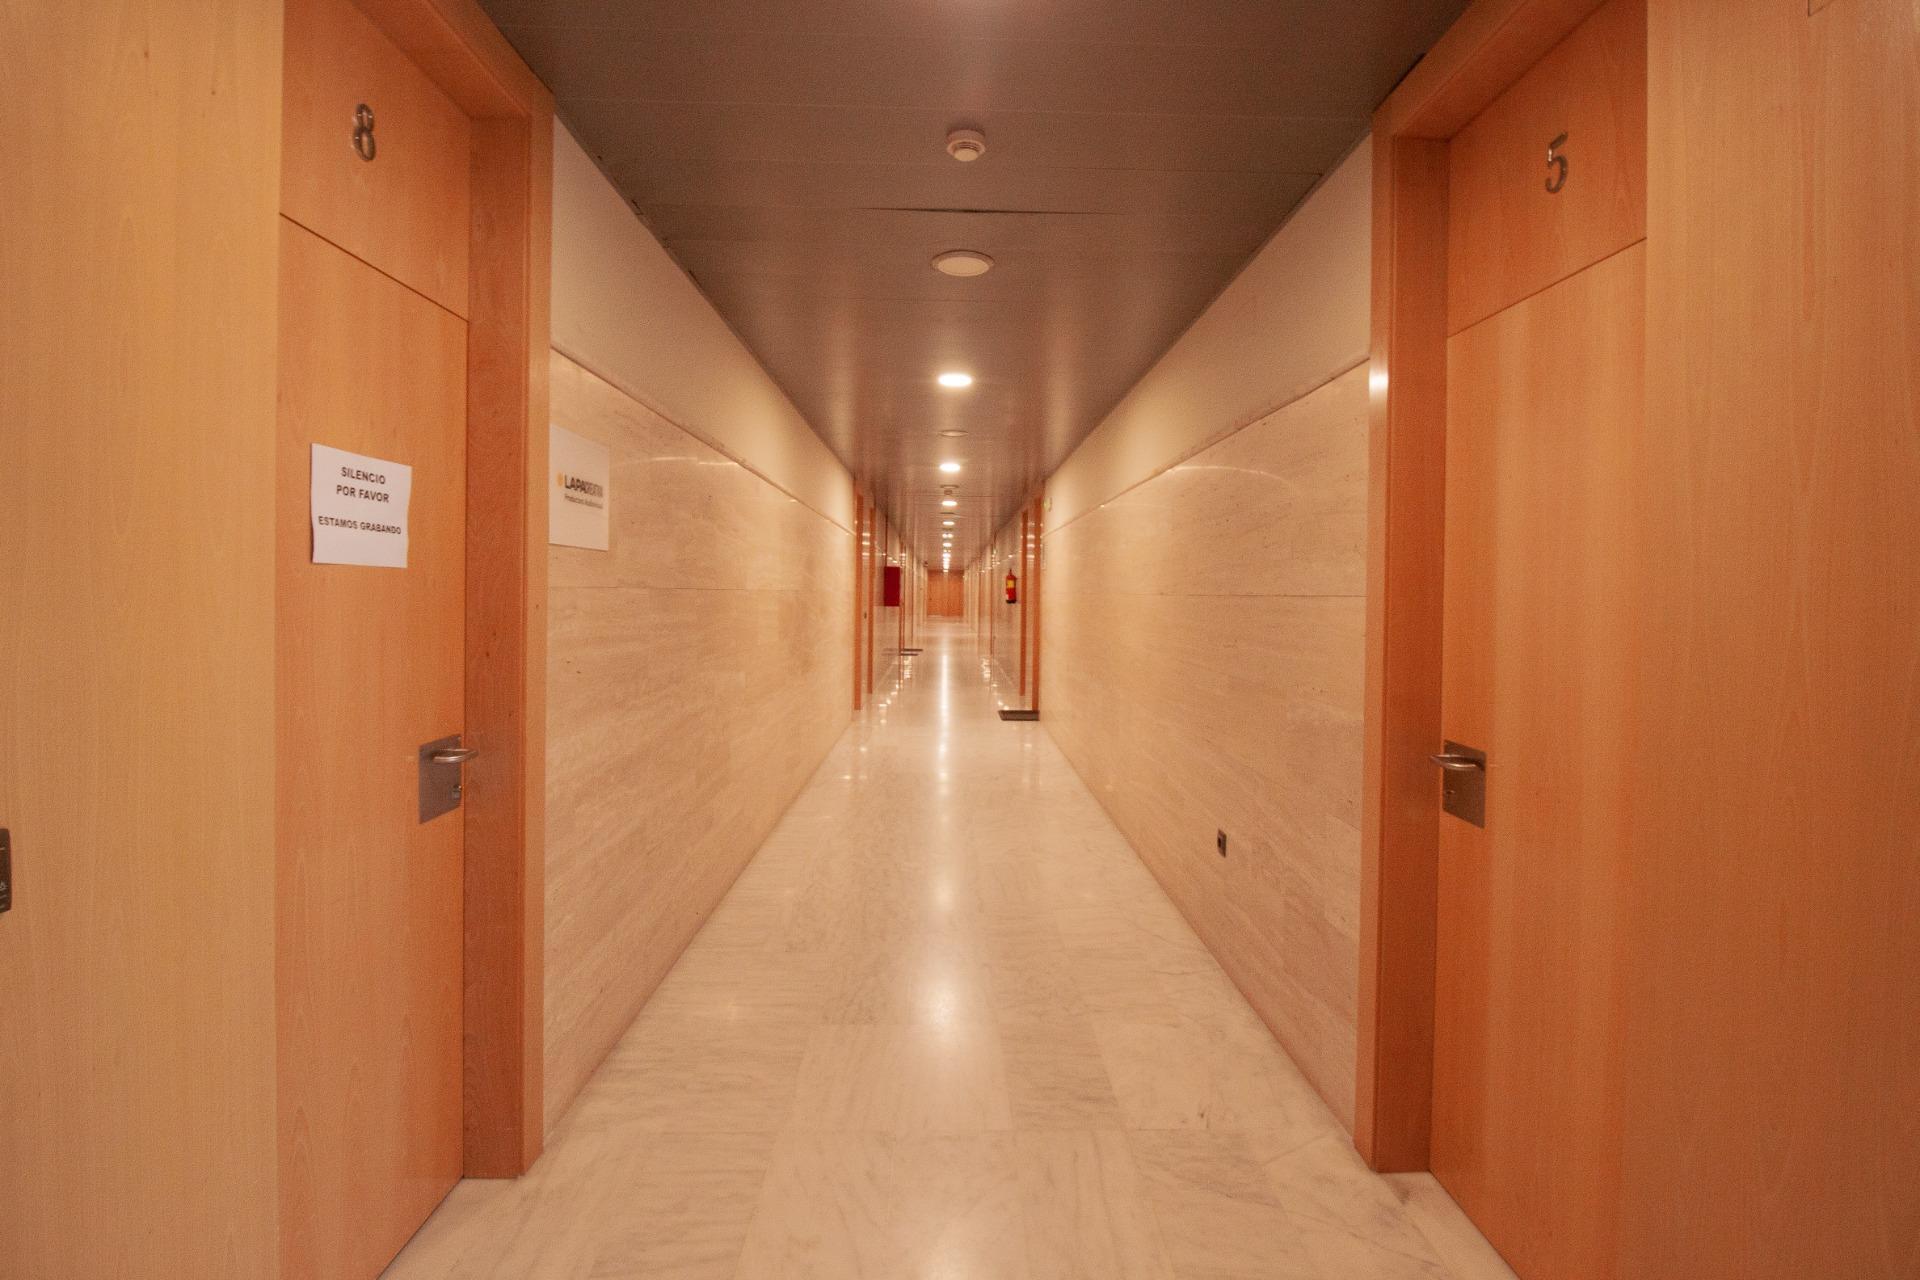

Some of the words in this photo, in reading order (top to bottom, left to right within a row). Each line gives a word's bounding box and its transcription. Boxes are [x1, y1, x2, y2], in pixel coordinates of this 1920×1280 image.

[353, 104, 376, 162] 8
[1545, 132, 1568, 193] 5
[341, 466, 386, 485] SILENCIO
[336, 484, 356, 498] POR
[359, 488, 389, 503] FAVOR
[318, 515, 358, 530] ESTAMOS
[360, 521, 401, 535] GRABANDO
